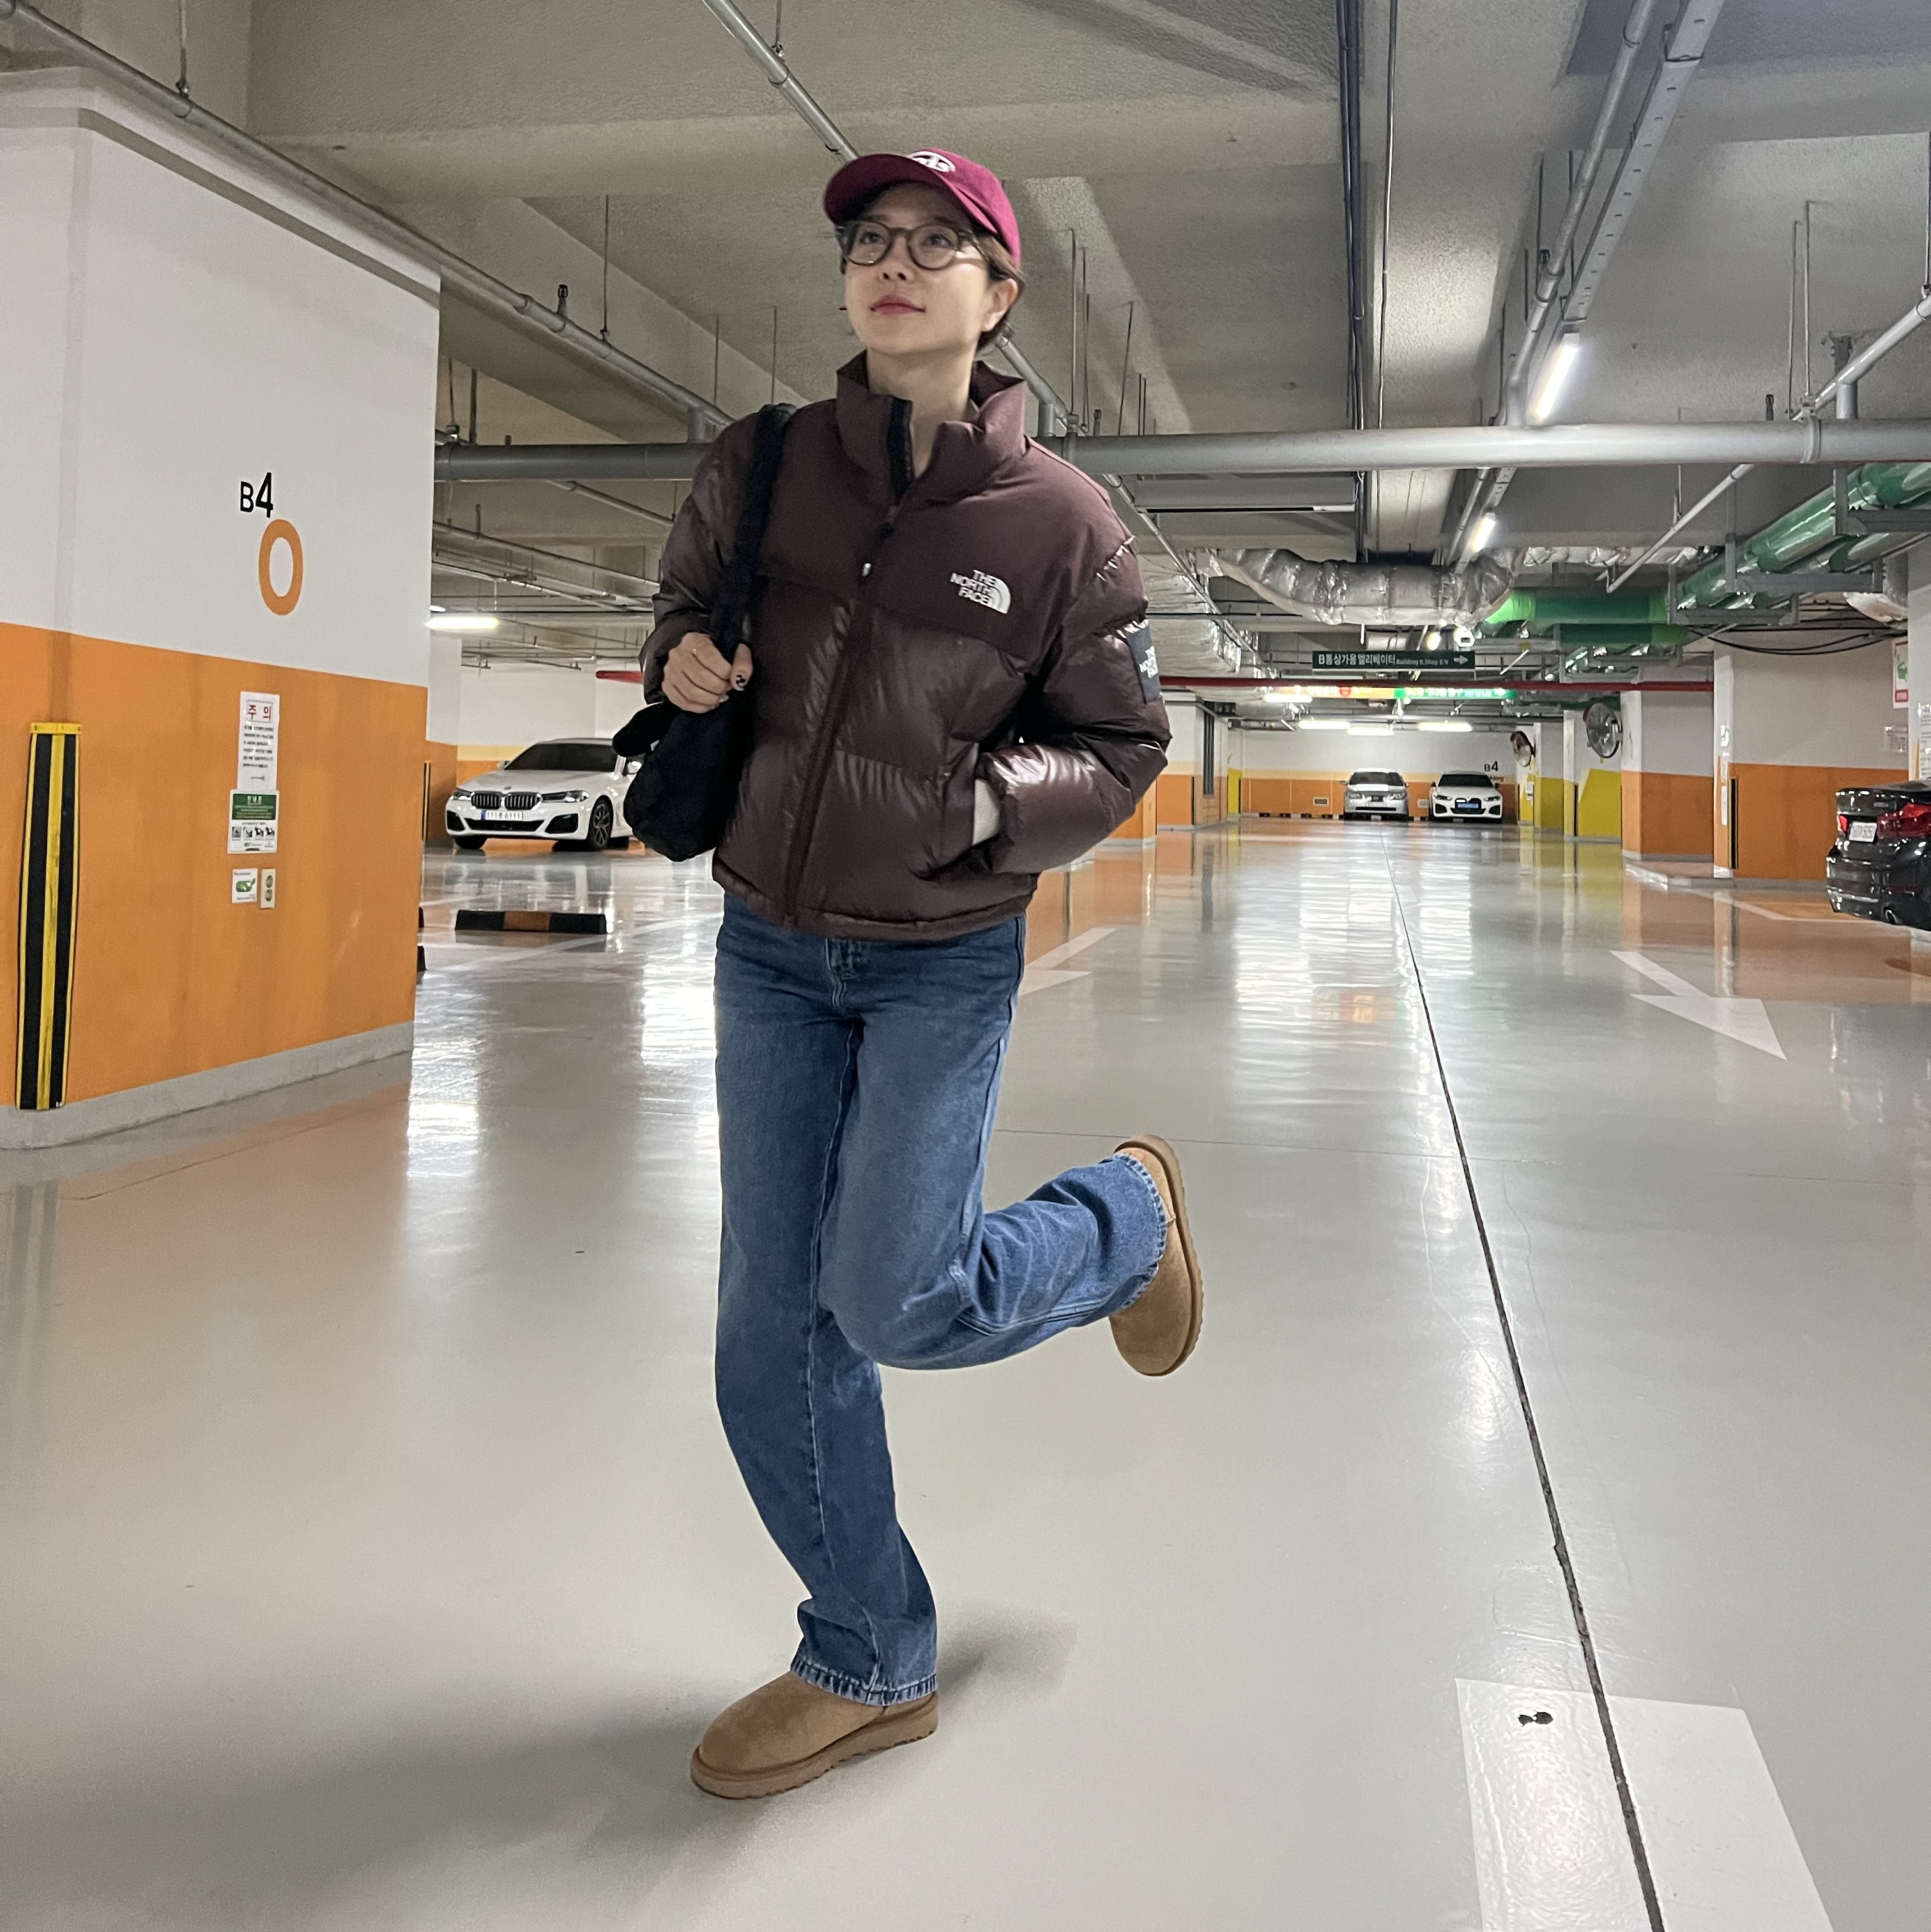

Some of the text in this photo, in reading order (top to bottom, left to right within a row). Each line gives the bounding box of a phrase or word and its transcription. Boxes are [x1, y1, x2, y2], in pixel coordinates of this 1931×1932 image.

[240, 472, 273, 518] B4
[950, 572, 991, 596] NORTH
[973, 569, 996, 586] THE
[958, 586, 990, 606] FACE
[1484, 761, 1499, 772] B4
